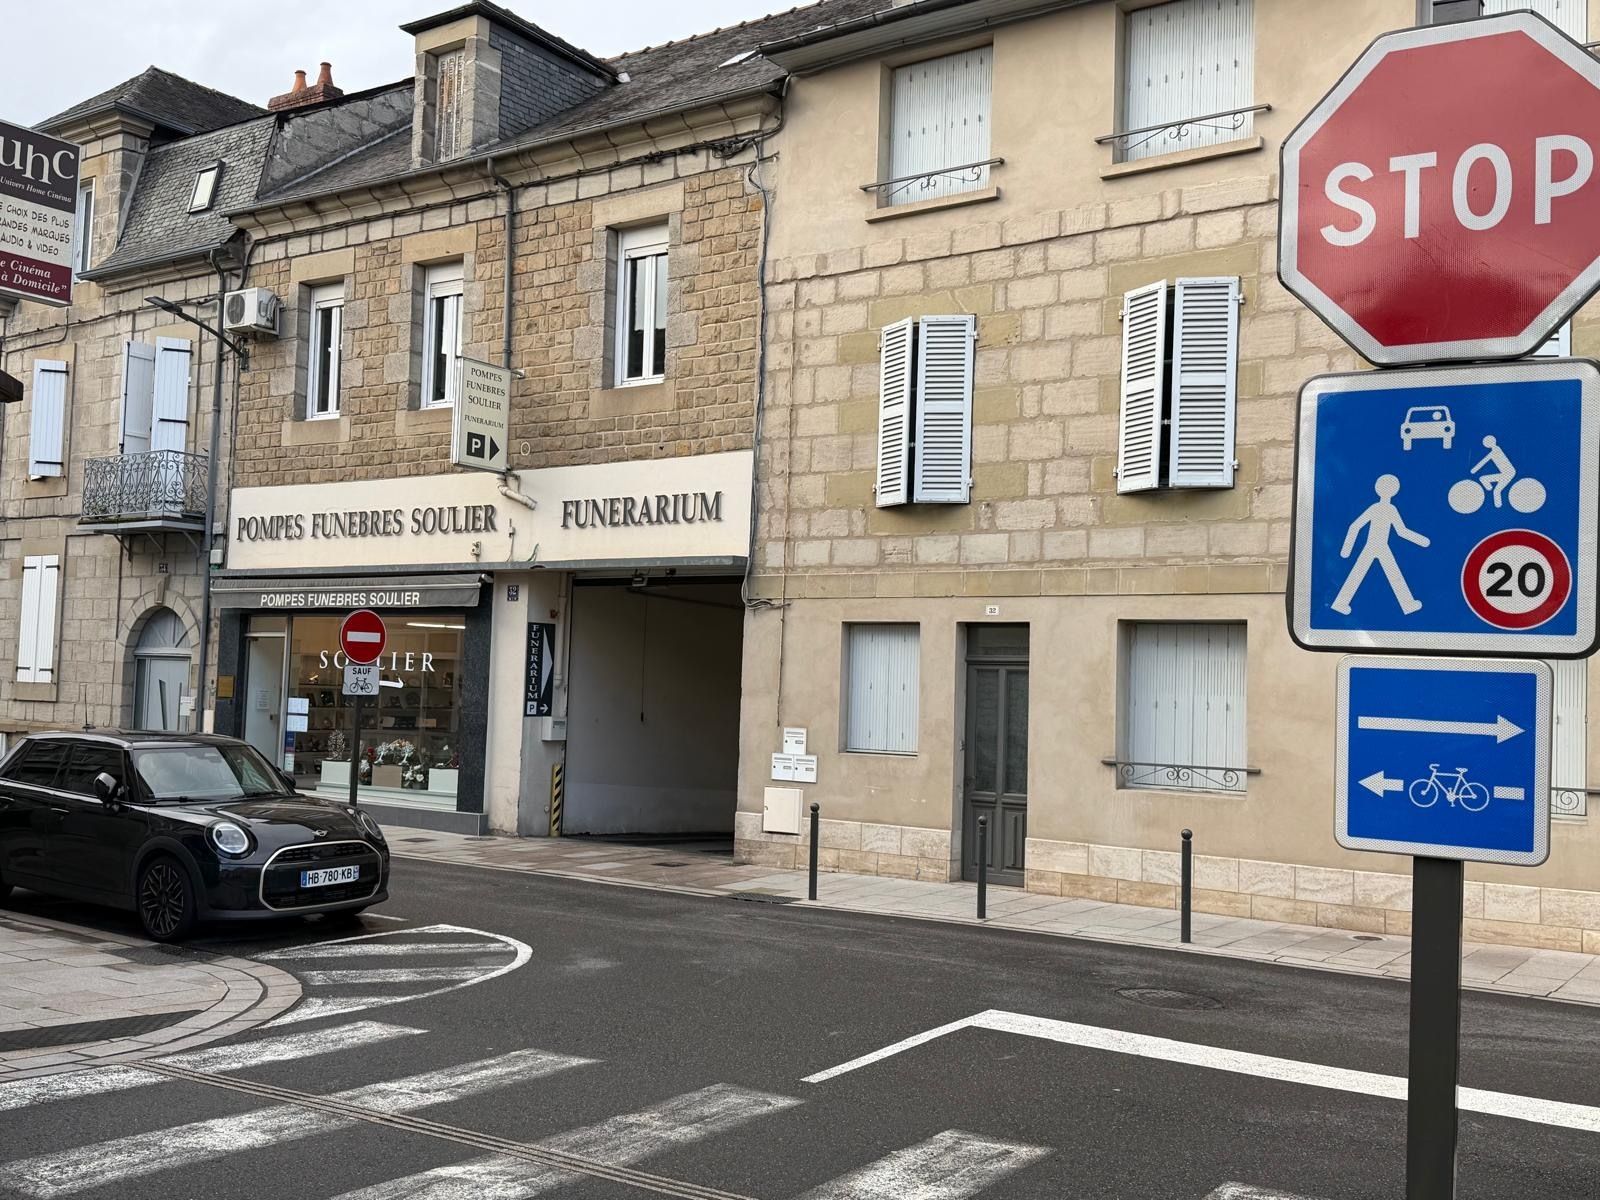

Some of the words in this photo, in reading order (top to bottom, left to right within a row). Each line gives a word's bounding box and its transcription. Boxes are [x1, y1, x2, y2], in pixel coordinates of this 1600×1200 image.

[0, 136, 75, 185] uhc
[26, 184, 46, 196] Home
[1320, 134, 1594, 247] STOP
[7, 204, 28, 218] CHOIX
[31, 210, 47, 223] DES
[51, 215, 70, 229] PLUS
[1, 232, 24, 247] AUDIO
[36, 243, 59, 256] VIDEO
[31, 226, 70, 244] MARQUES
[1, 271, 9, 281] à
[10, 259, 51, 279] Cinéma
[471, 368, 502, 382] POMPES
[466, 380, 505, 396] FUNEBRES
[468, 395, 501, 410] SOULIER
[464, 414, 504, 429] FUNERARIUM
[471, 438, 481, 453] P
[560, 490, 723, 529] FUNERARIUM
[237, 513, 305, 542] POMPES
[310, 508, 404, 539] FUNEBRES
[410, 503, 498, 535] SOULIER
[1486, 561, 1546, 598] 20
[260, 593, 305, 607] POMPES
[307, 592, 367, 606] FUNEBRES
[369, 592, 420, 605] SOULIER
[319, 650, 436, 673] SOLIER
[527, 624, 540, 699] FUNERARIUM
[352, 667, 372, 675] SAUF
[529, 704, 535, 713] P
